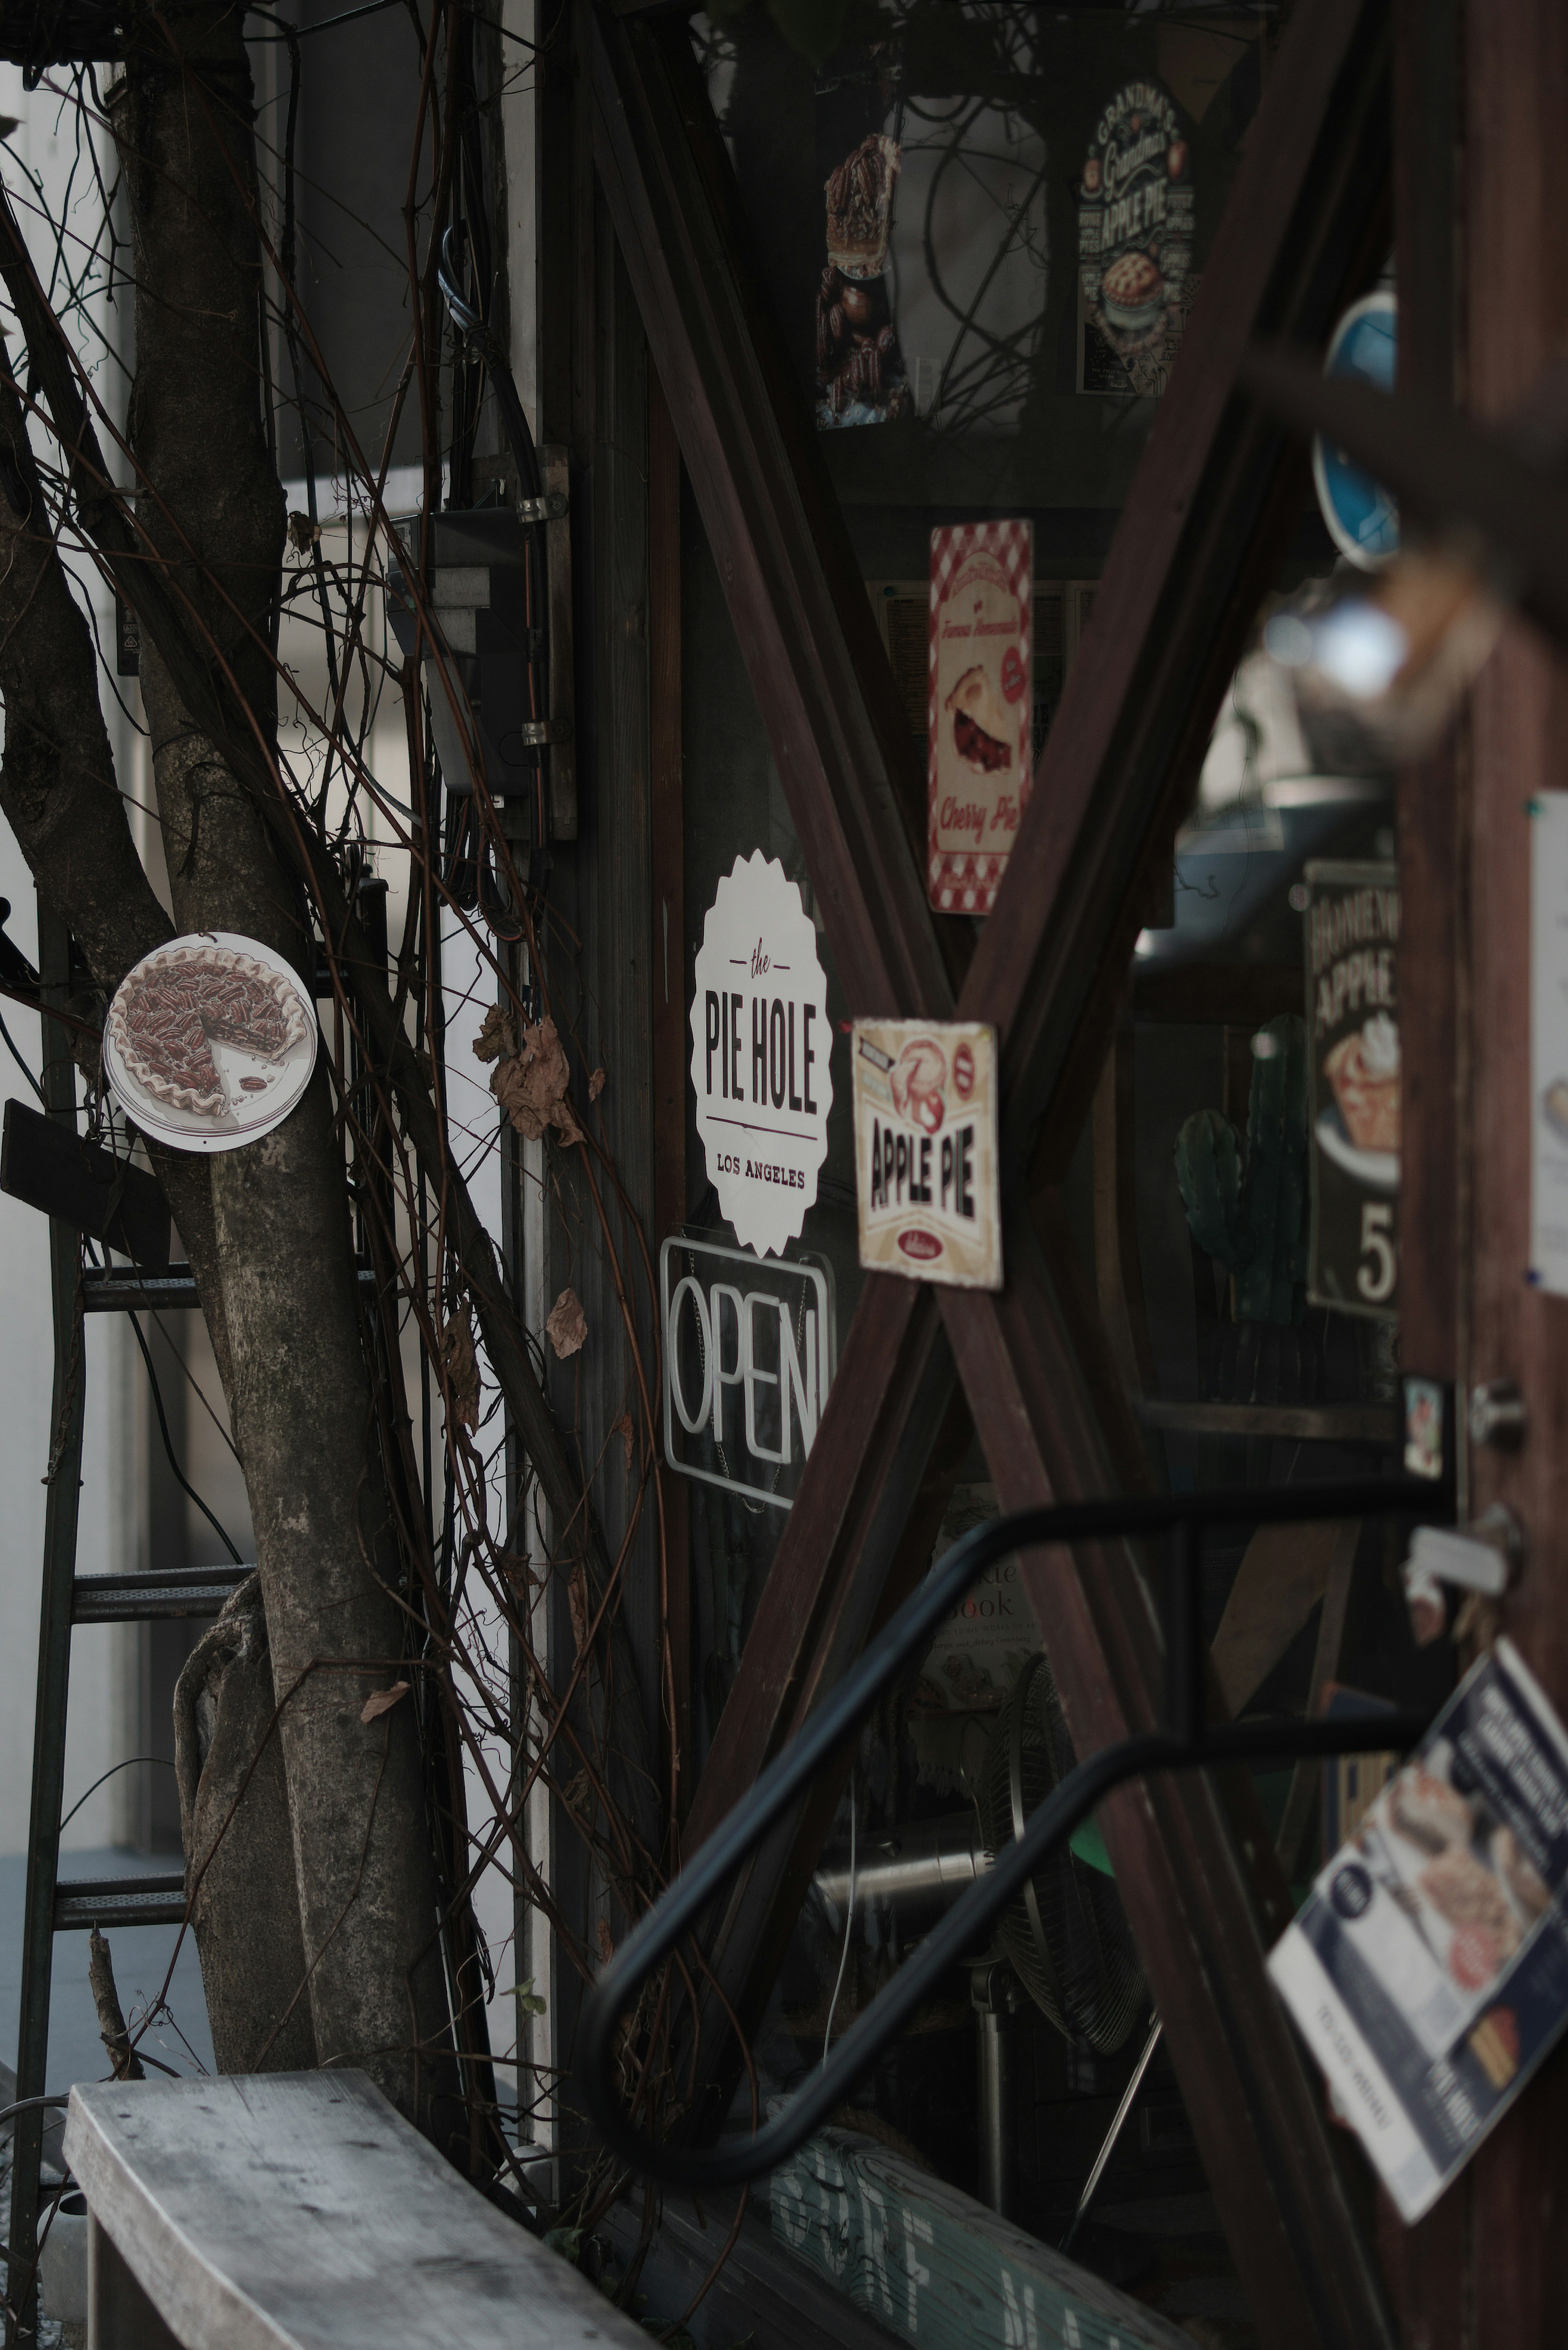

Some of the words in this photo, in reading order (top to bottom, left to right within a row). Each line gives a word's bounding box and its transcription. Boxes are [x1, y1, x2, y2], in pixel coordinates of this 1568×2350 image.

[1101, 190, 1141, 251] APPLE
[1144, 177, 1169, 227] PIE
[940, 796, 987, 845] Cherry
[989, 796, 1018, 832] Pie
[751, 937, 770, 979] the
[1315, 948, 1397, 1040] APPLE
[706, 990, 744, 1101] PIE
[752, 997, 817, 1115] HOLE
[717, 1153, 740, 1175] LOS
[745, 1162, 805, 1189] ANGELES
[871, 1117, 933, 1210] APPLE
[940, 1124, 976, 1218] PIE
[670, 1275, 816, 1465] OPEN
[954, 1626, 978, 1635] EDIBLE
[983, 1623, 1009, 1632] WORKS
[969, 1638, 994, 1648] Abbey
